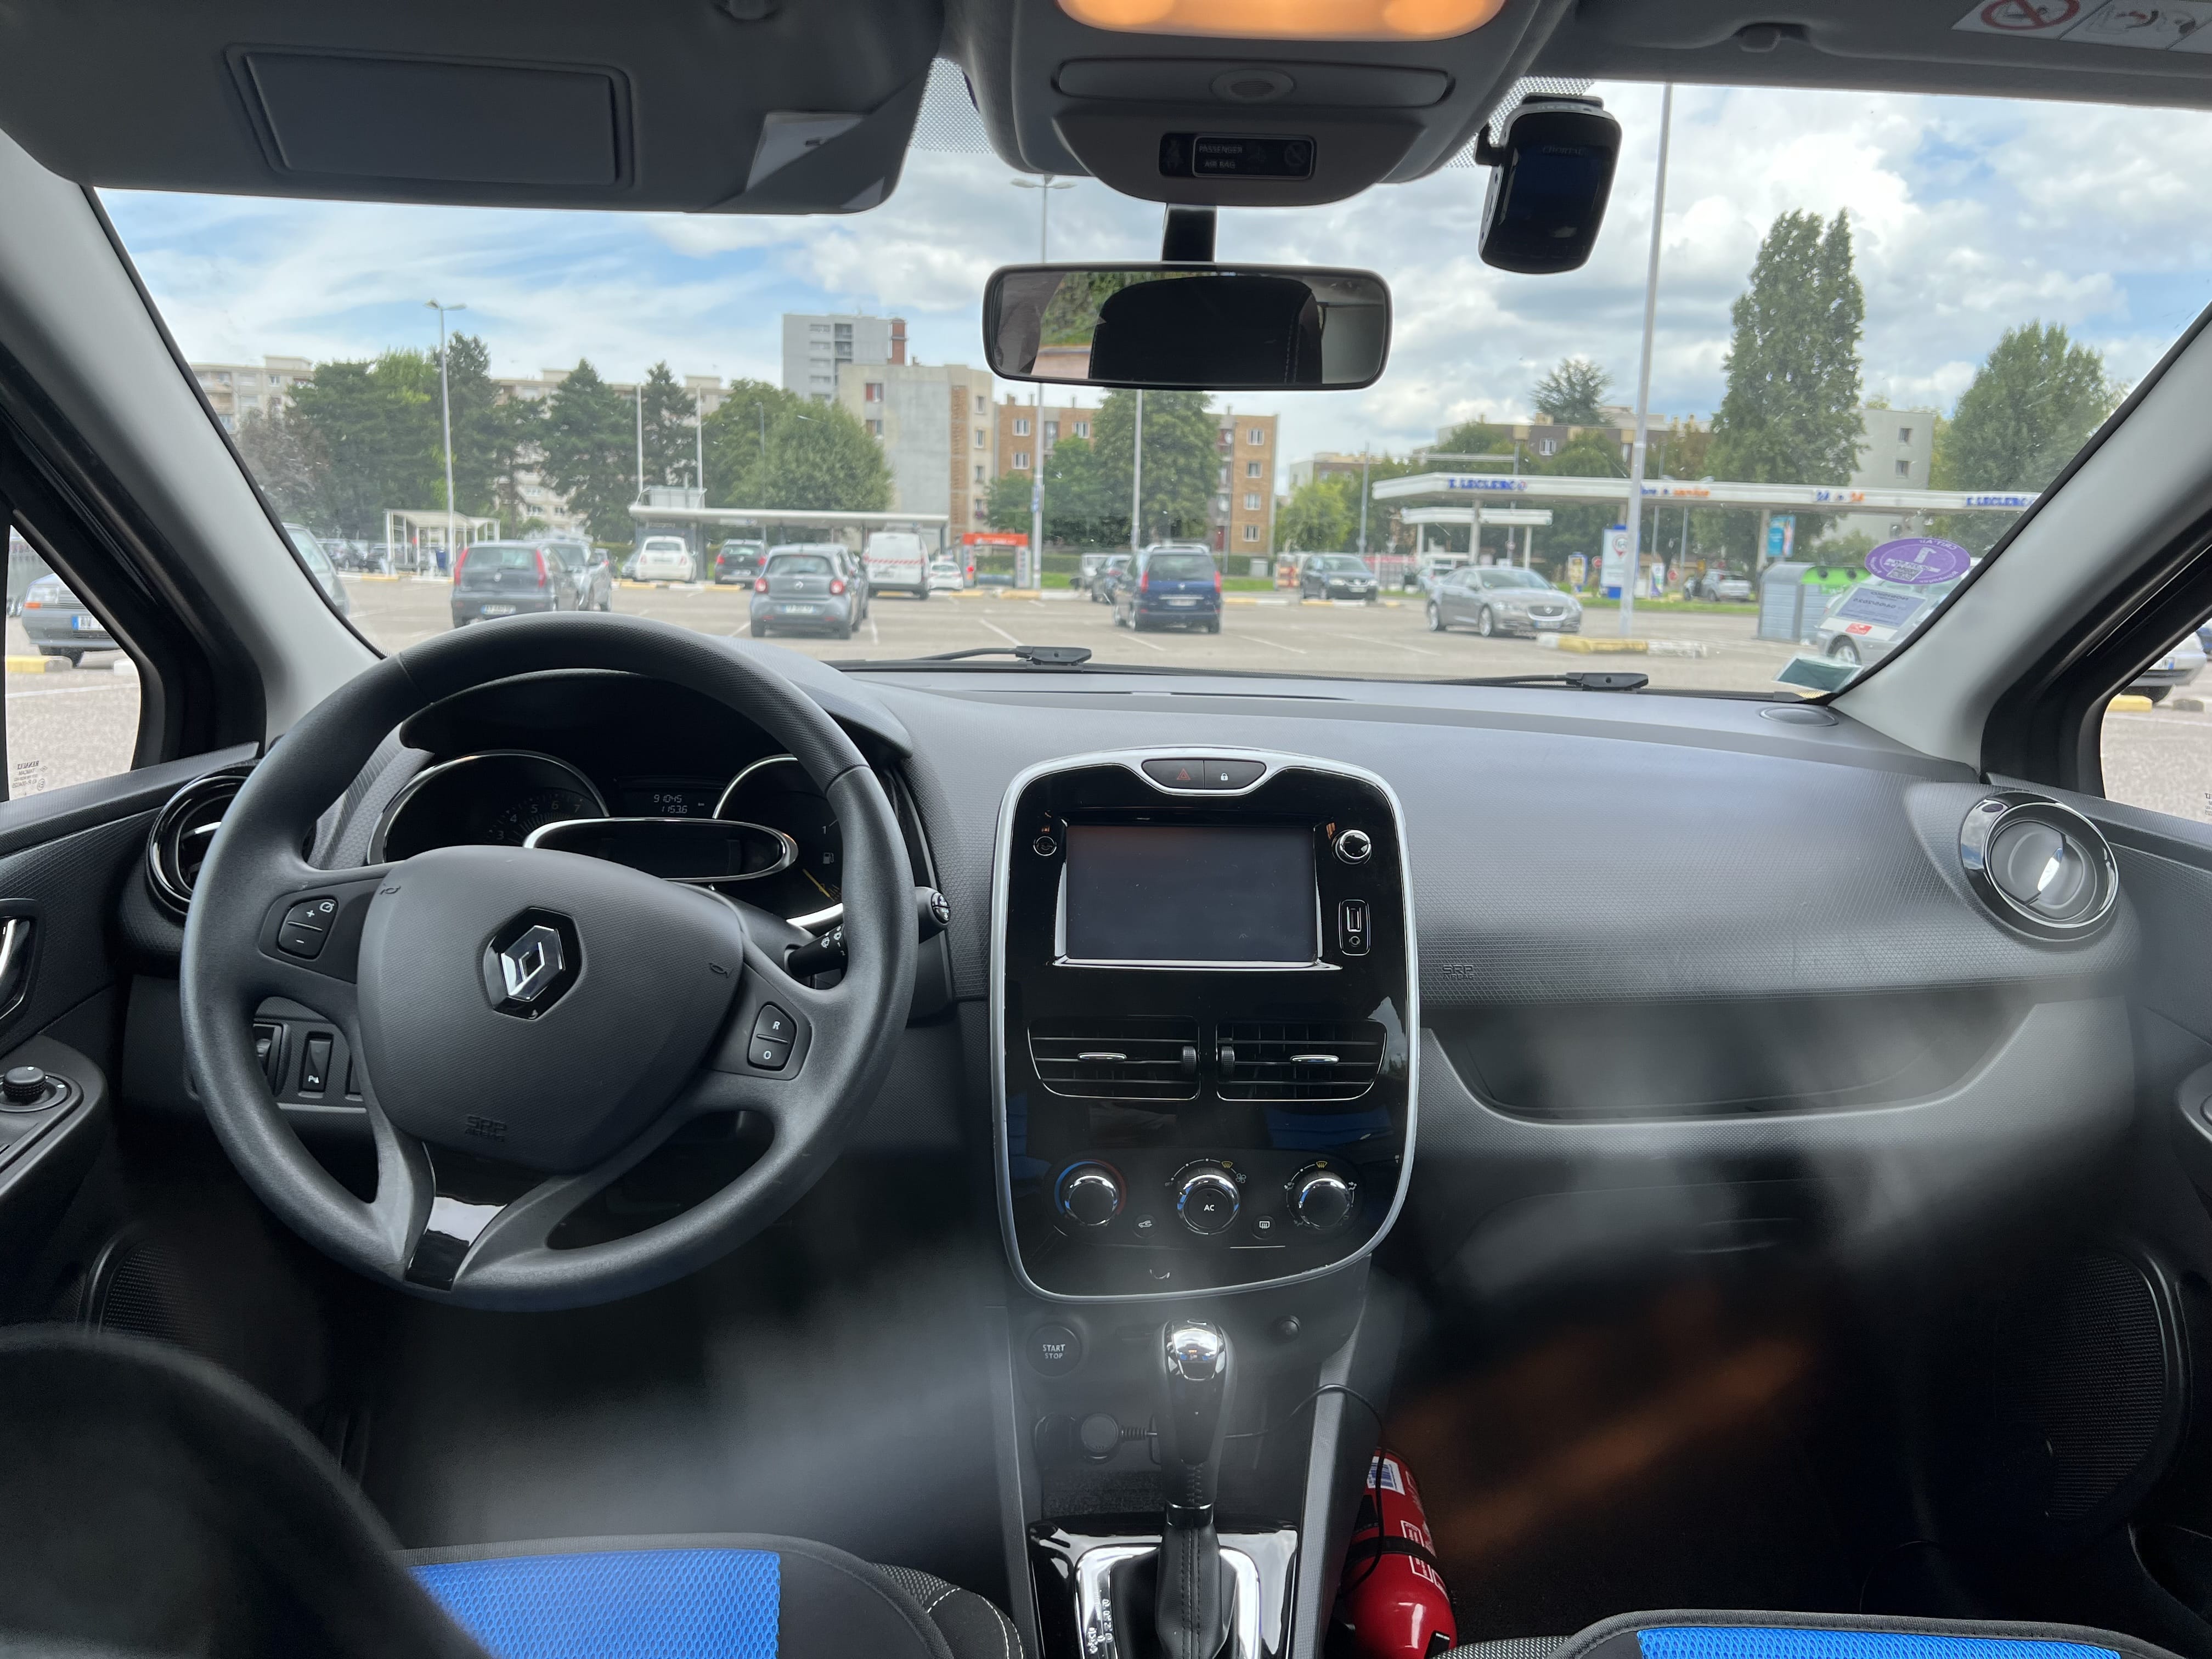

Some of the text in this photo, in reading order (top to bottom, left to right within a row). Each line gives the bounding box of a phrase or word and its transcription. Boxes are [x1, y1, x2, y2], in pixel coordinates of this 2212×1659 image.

[1199, 144, 1243, 154] PASSENGER
[1205, 159, 1235, 168] AIR BAG
[531, 804, 538, 813] 5
[574, 804, 581, 812] 7
[510, 814, 517, 822] 4
[772, 1021, 780, 1030] R
